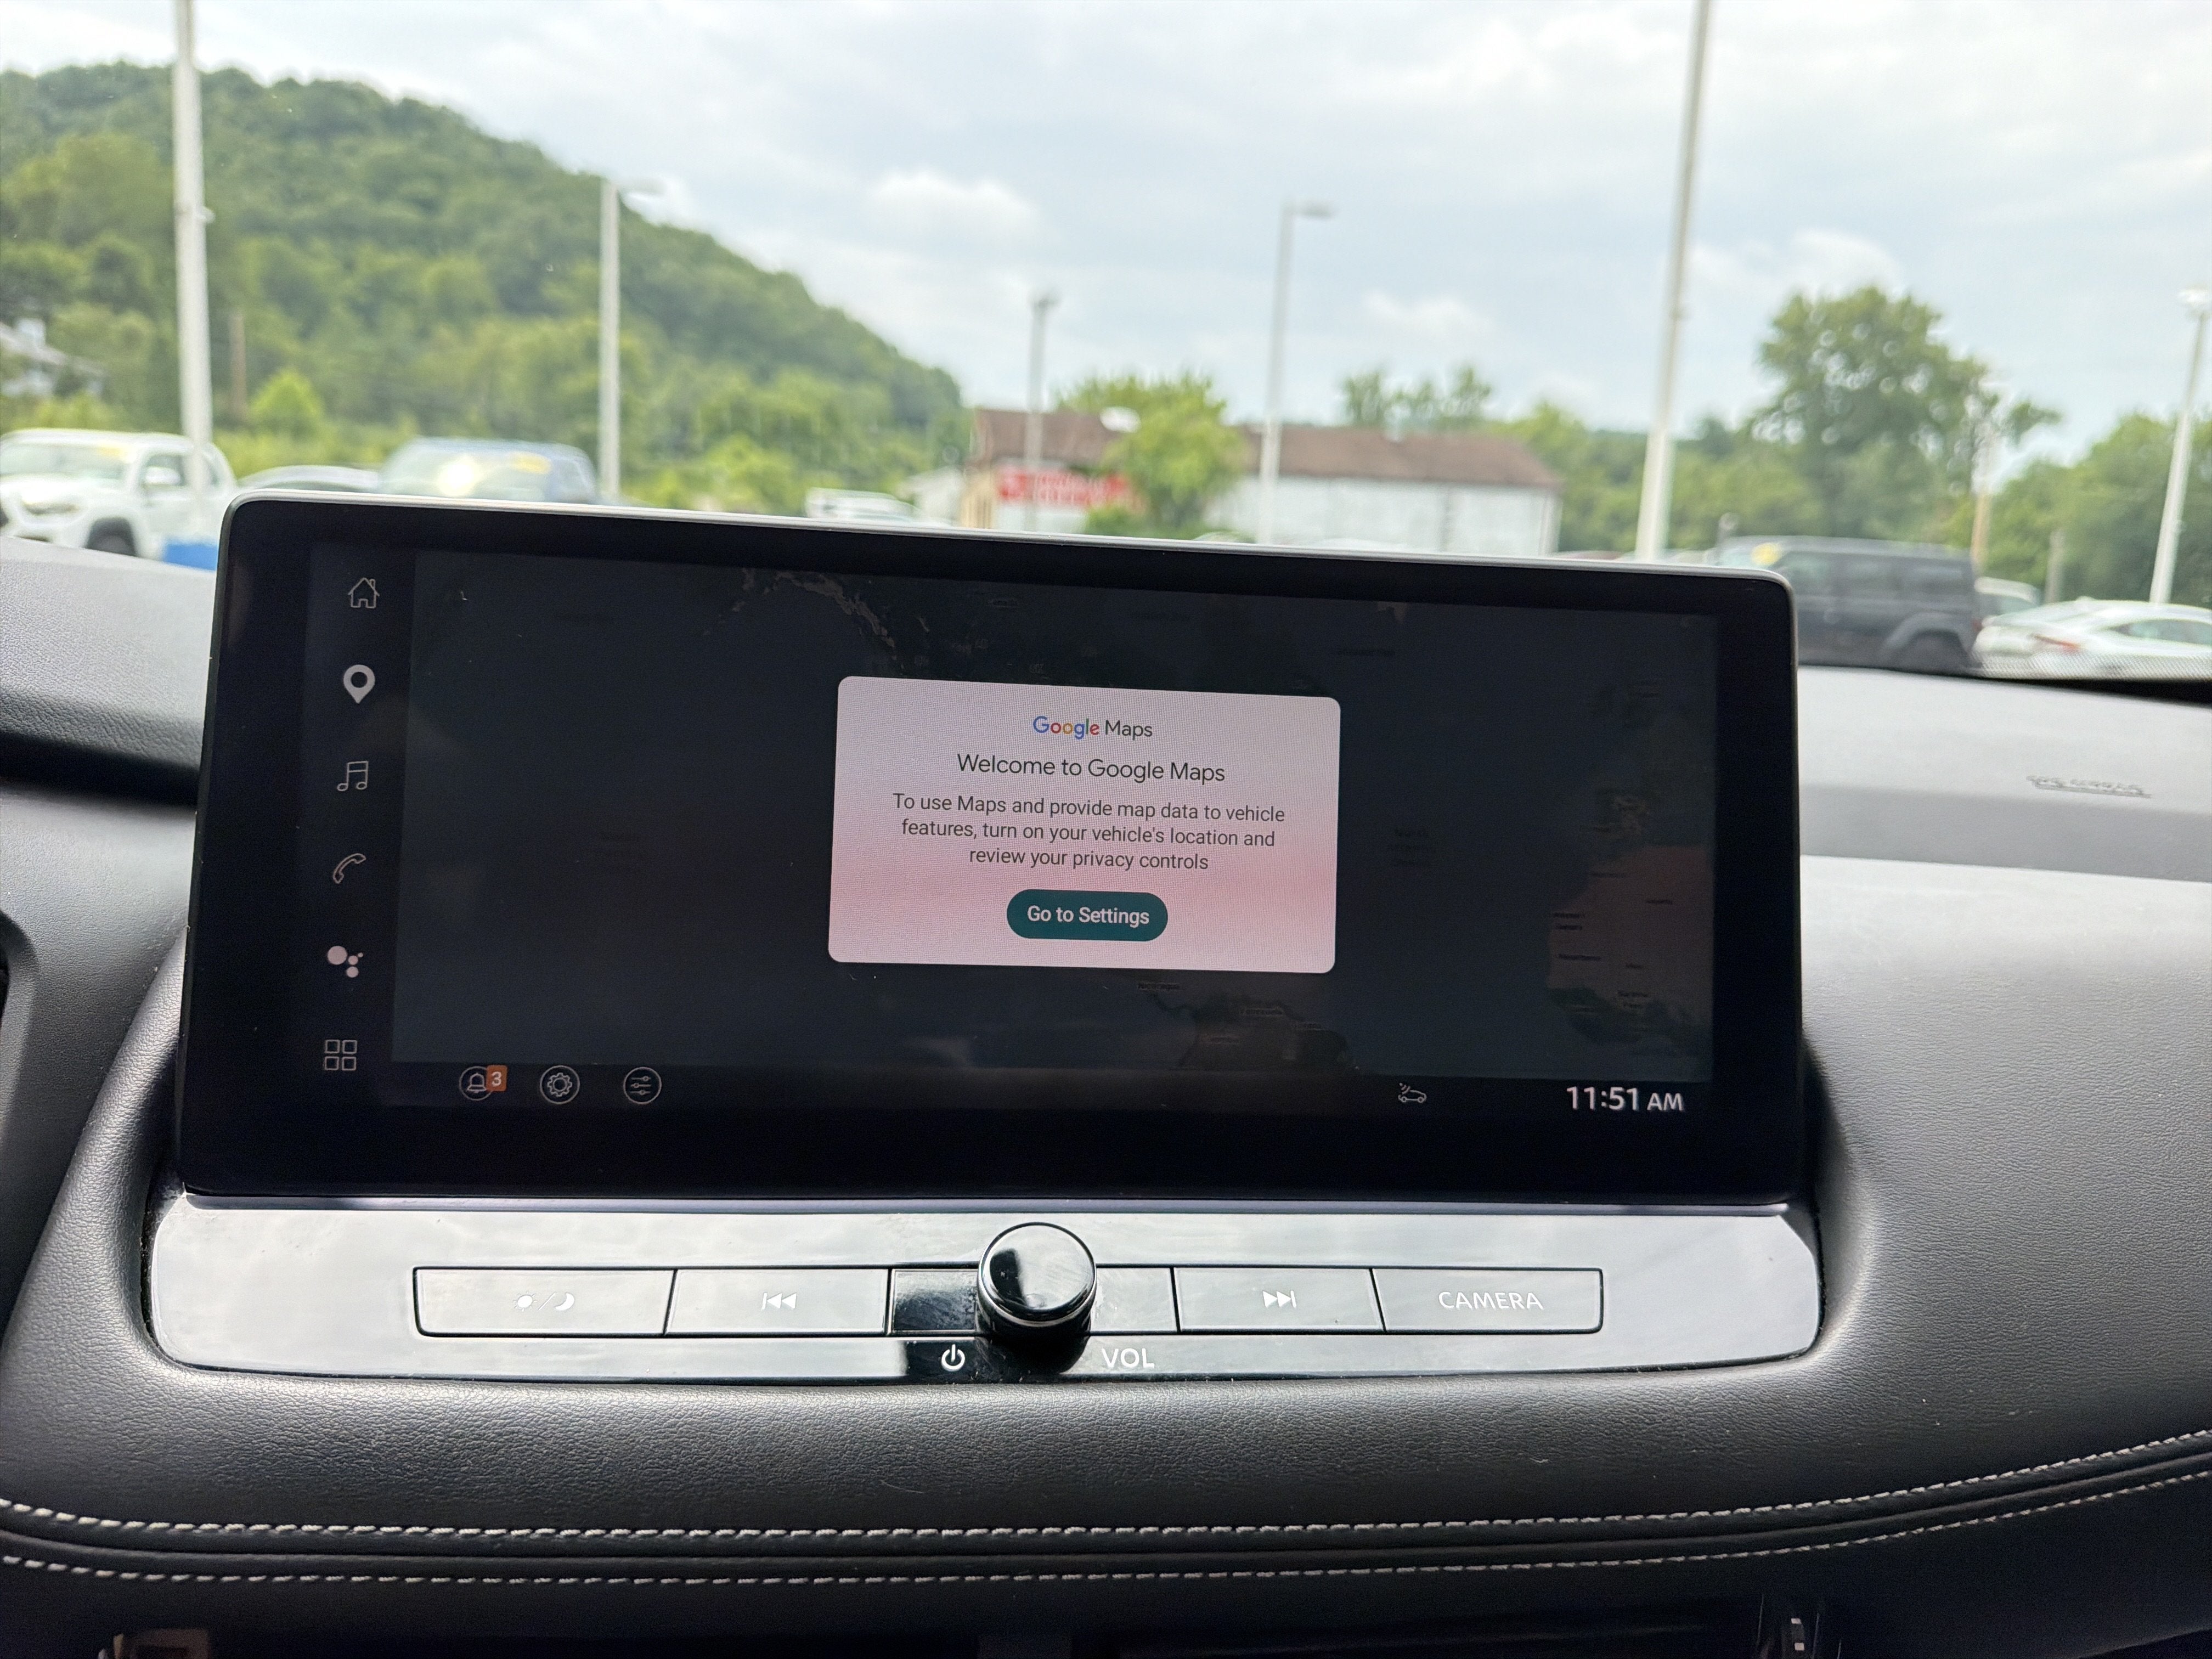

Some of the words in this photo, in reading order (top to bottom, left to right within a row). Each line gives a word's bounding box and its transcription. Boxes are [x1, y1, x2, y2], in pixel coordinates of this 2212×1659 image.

[1033, 716, 1099, 740] Google
[1105, 720, 1152, 740] Maps
[957, 754, 1055, 775] Welcome
[1062, 759, 1082, 776] to
[1088, 759, 1164, 783] Google
[1171, 762, 1224, 785] Maps
[893, 793, 915, 809] To
[921, 798, 952, 810] use
[958, 795, 1006, 815] Maps
[1013, 798, 1044, 813] and
[1050, 800, 1112, 817] provide
[1118, 805, 1155, 821] map
[1161, 803, 1198, 819] data
[1204, 805, 1221, 820] to
[1226, 805, 1285, 822] vehicle
[902, 819, 977, 839] features,
[983, 823, 1017, 838] turn
[1023, 827, 1043, 838] on
[1049, 828, 1087, 843] your
[1092, 826, 1164, 843] vehicle's
[1171, 828, 1238, 845] location
[1244, 831, 1274, 846] and
[970, 848, 1026, 864] review
[1031, 853, 1067, 868] your
[1073, 851, 1134, 871] privacy
[1139, 854, 1208, 870] controls
[1027, 905, 1052, 922] Go
[1056, 906, 1075, 923] to
[1079, 906, 1150, 928] Settings
[492, 1072, 501, 1086] 3
[1567, 1087, 1638, 1110] 11:51
[1647, 1093, 1684, 1111] AM
[1438, 1291, 1544, 1310] CAMERA
[1102, 1348, 1155, 1369] VOL
